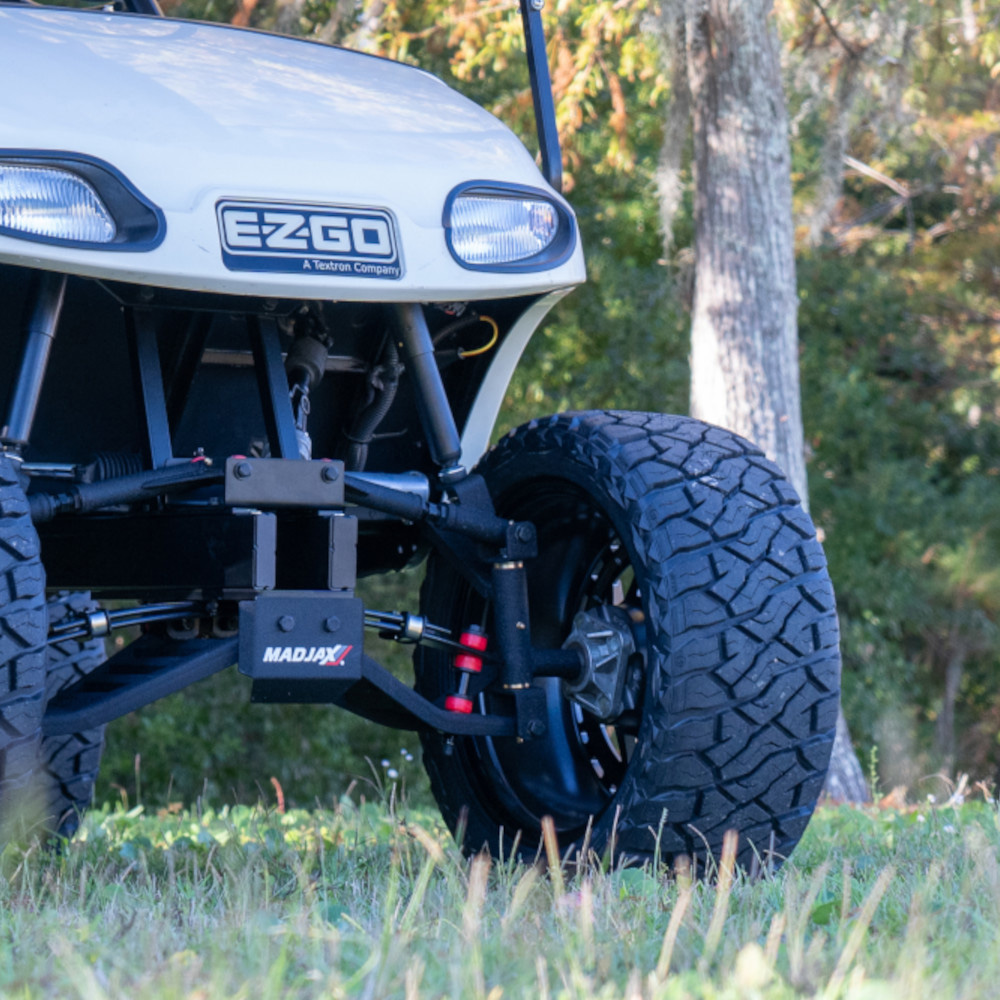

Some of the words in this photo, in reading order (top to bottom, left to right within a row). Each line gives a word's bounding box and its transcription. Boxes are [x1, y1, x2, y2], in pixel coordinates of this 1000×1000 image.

[303, 260, 312, 270] A
[312, 260, 352, 272] Textron
[354, 262, 400, 276] Company
[262, 644, 353, 666] MADJAX
